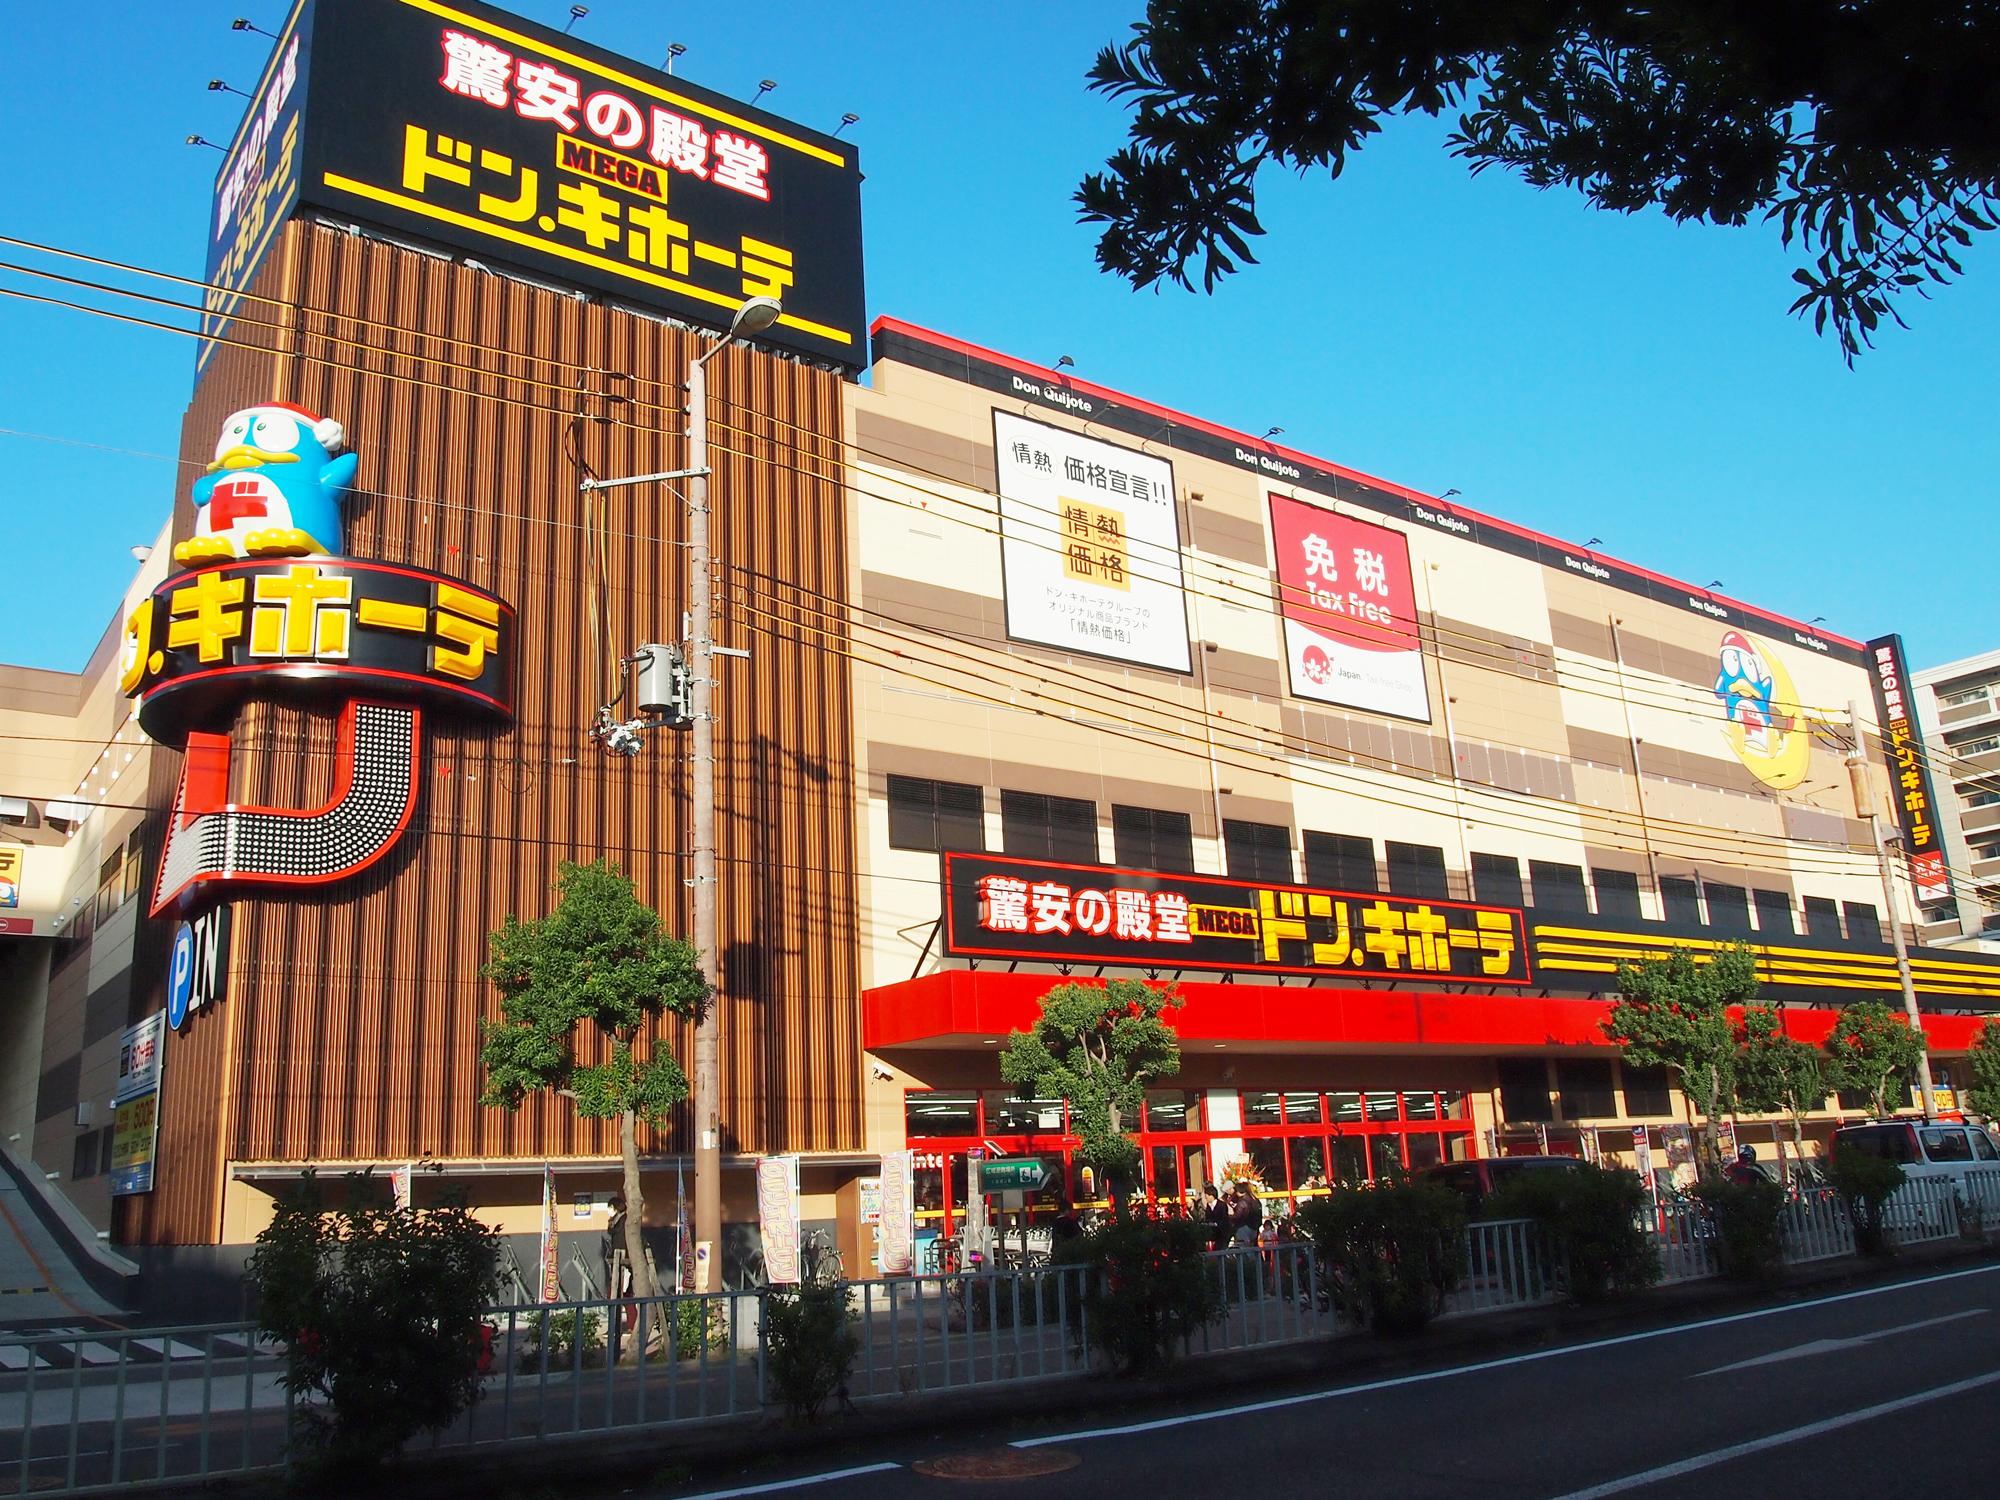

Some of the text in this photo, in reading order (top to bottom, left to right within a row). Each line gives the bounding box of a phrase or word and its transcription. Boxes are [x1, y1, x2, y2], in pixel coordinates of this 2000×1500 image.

[442, 29, 769, 201] 驚安の殿堂
[562, 138, 664, 197] MEGA
[1012, 376, 1092, 413] Don Quijote
[1012, 440, 1052, 474] 情熱
[1235, 448, 1300, 479] Don Quijote
[209, 481, 268, 532] ド
[1065, 505, 1120, 538] 情熱
[1416, 507, 1470, 533] Don Quijote
[1068, 543, 1123, 584] 価格
[1302, 533, 1389, 597] 免税
[1565, 556, 1610, 579] Don Quijote
[1306, 580, 1392, 625] Tax Free
[1689, 597, 1704, 610] Don
[984, 876, 1192, 943] 驚安の殿堂
[1196, 907, 1257, 936] MEGA
[172, 905, 221, 1015] P IN
